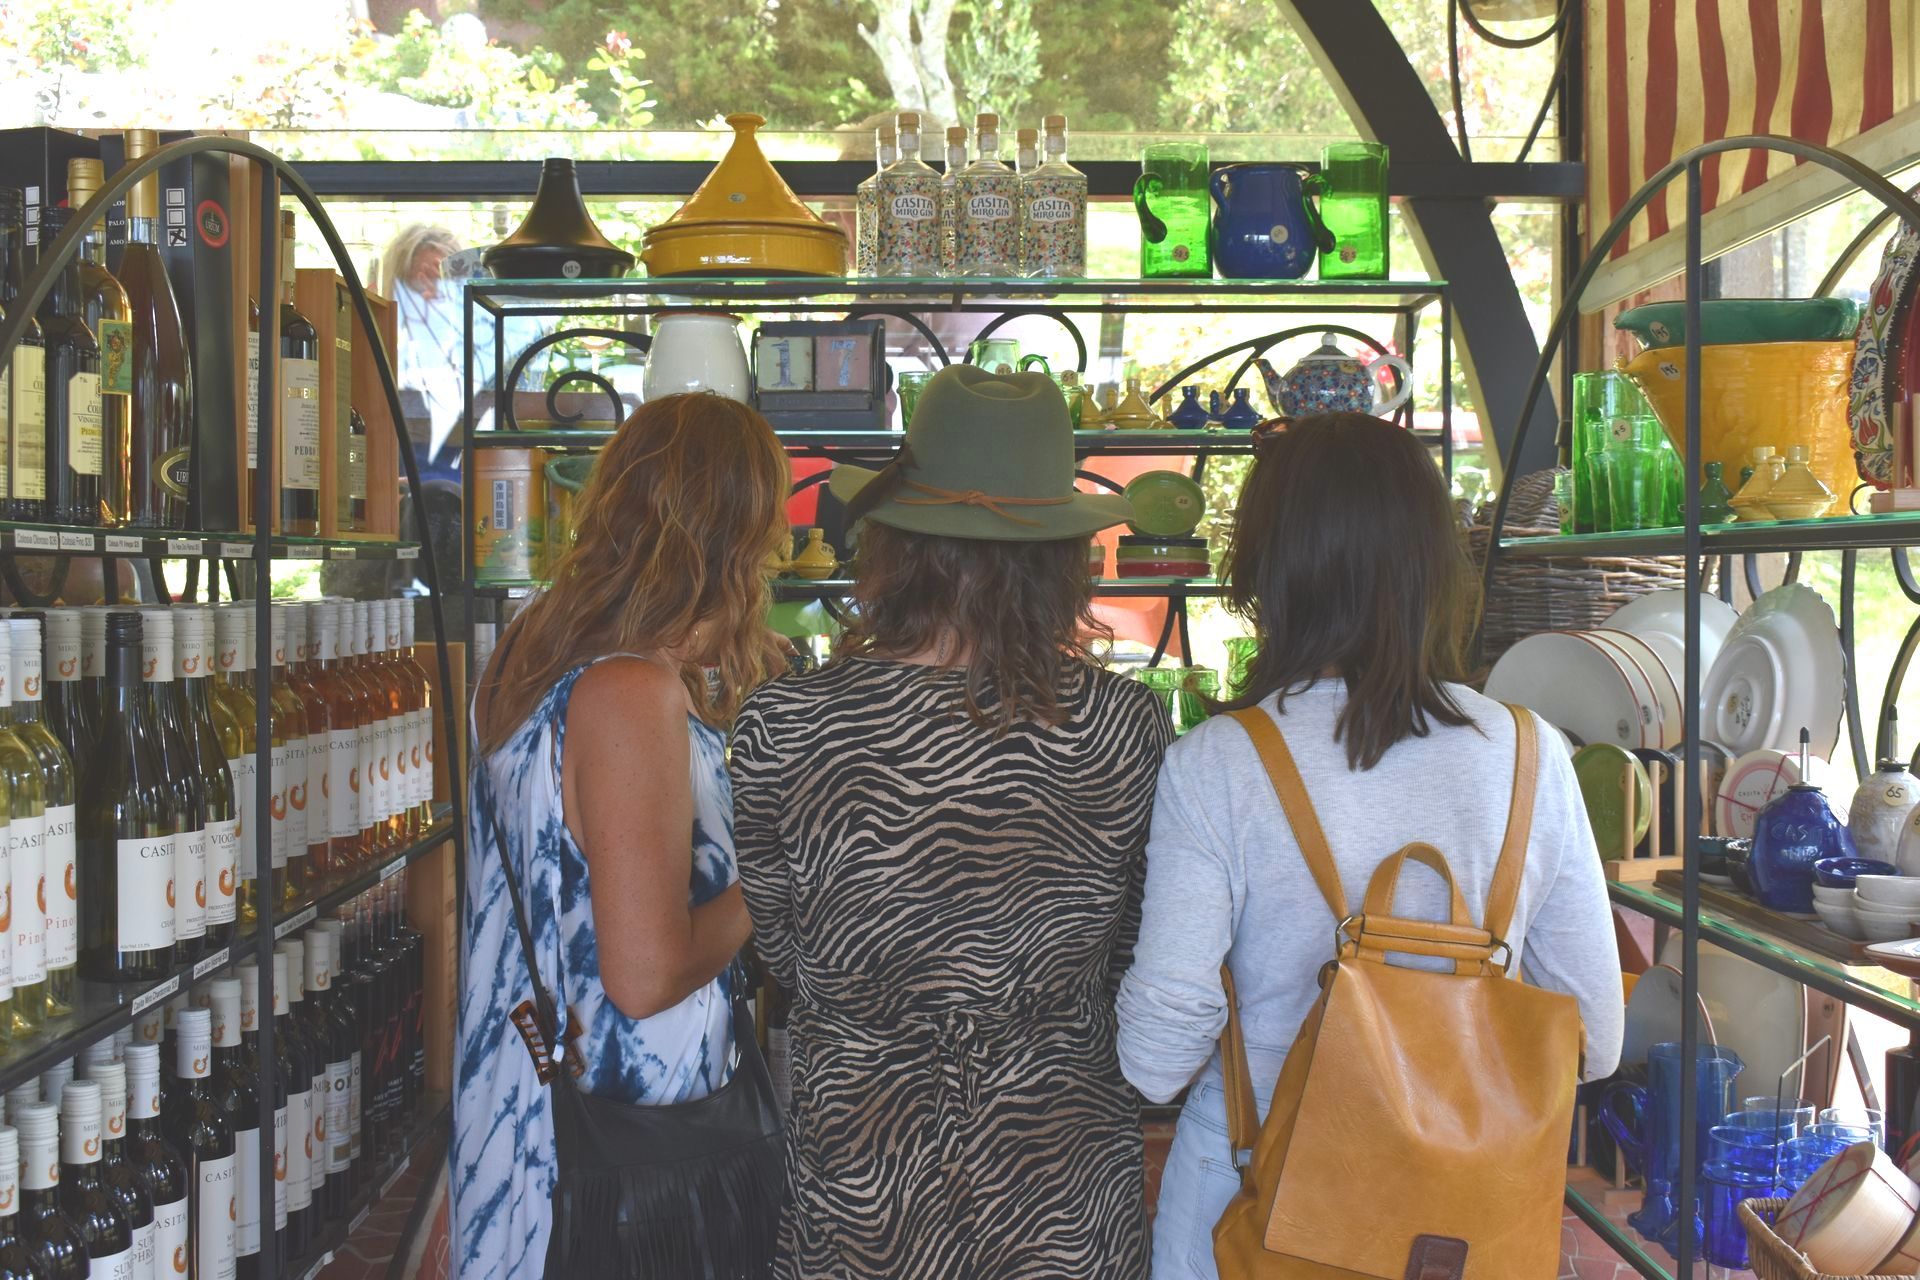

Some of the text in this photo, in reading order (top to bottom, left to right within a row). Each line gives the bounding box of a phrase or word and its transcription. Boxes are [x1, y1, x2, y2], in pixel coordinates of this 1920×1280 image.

[894, 198, 933, 208] CASITA
[971, 198, 1010, 208] CASITA
[1032, 200, 1070, 211] CASITA
[895, 208, 918, 217] MIRO
[972, 208, 994, 217] MIRO
[1033, 211, 1054, 219] MIRO
[771, 339, 856, 387] 1 7
[1886, 786, 1904, 798] 65
